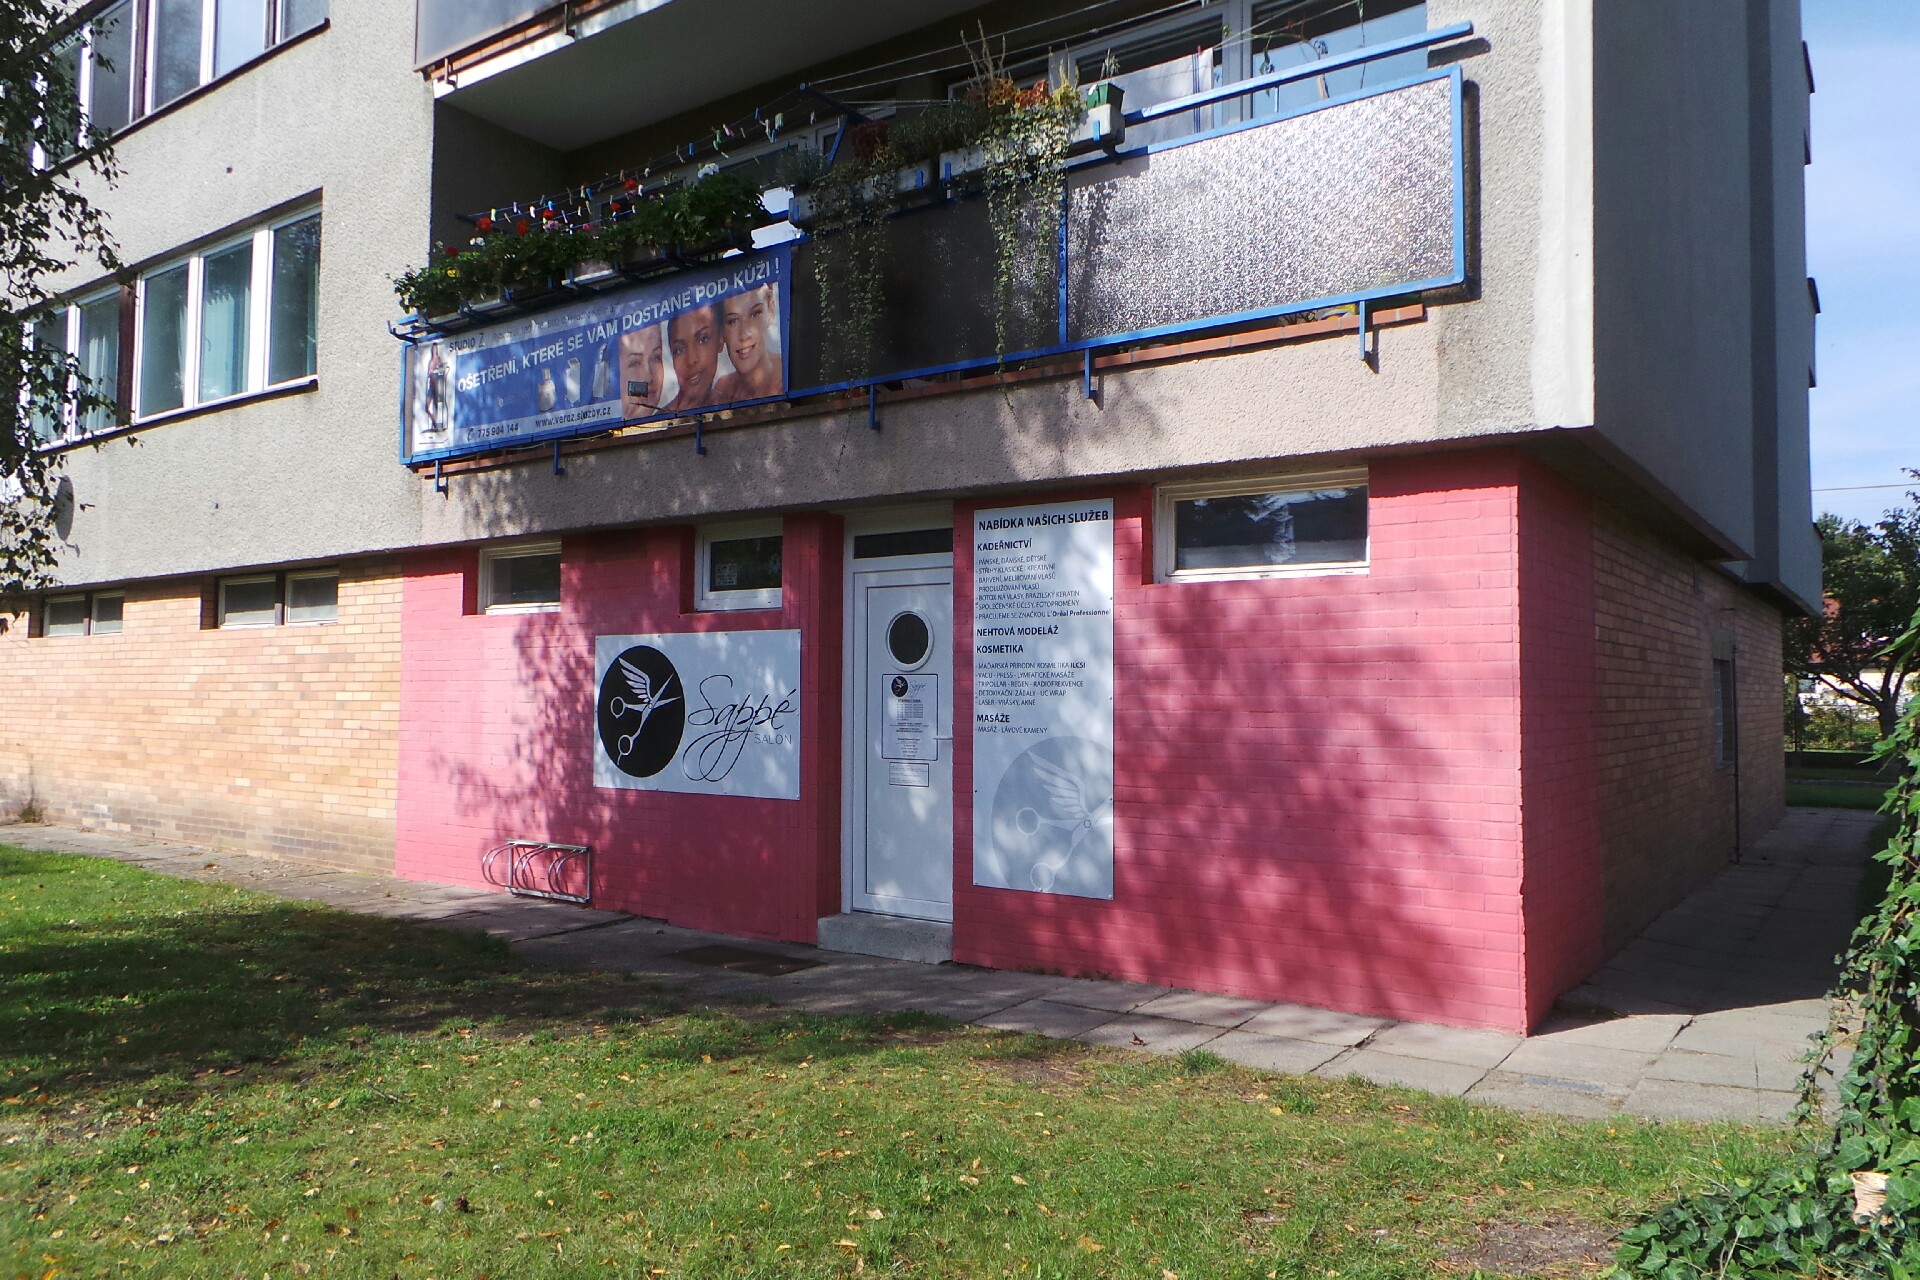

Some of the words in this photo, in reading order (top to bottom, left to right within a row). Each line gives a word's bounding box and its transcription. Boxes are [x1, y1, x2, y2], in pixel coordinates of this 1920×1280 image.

[457, 355, 520, 393] OŠETŘENÍ,
[522, 340, 564, 369] KTERÉ
[567, 333, 584, 352] SE
[586, 318, 618, 344] VÁM
[622, 290, 691, 331] DOSTANE
[696, 277, 729, 303] POD
[733, 260, 771, 289] KŮŽI
[450, 338, 476, 352] STUDIO
[477, 428, 491, 439] 775
[491, 426, 504, 437] 904
[507, 423, 519, 433] 144
[978, 517, 1024, 531] NABÍDKA
[1026, 513, 1066, 527] NAŠICH
[1067, 510, 1109, 524] SLUŽEB
[977, 538, 1033, 552] KADEŘNICTVÍ
[1026, 554, 1047, 563] DĚTSKÉ
[1056, 590, 1080, 598] KERATIN
[976, 626, 1015, 637] NEHTOVÁ
[1017, 624, 1059, 636] MODELÁŽ
[976, 644, 1024, 654] KOSMETIKA
[1050, 670, 1075, 678] MASÁŽE
[976, 712, 1010, 723] MASÁŽE
[754, 733, 792, 745] SALON
